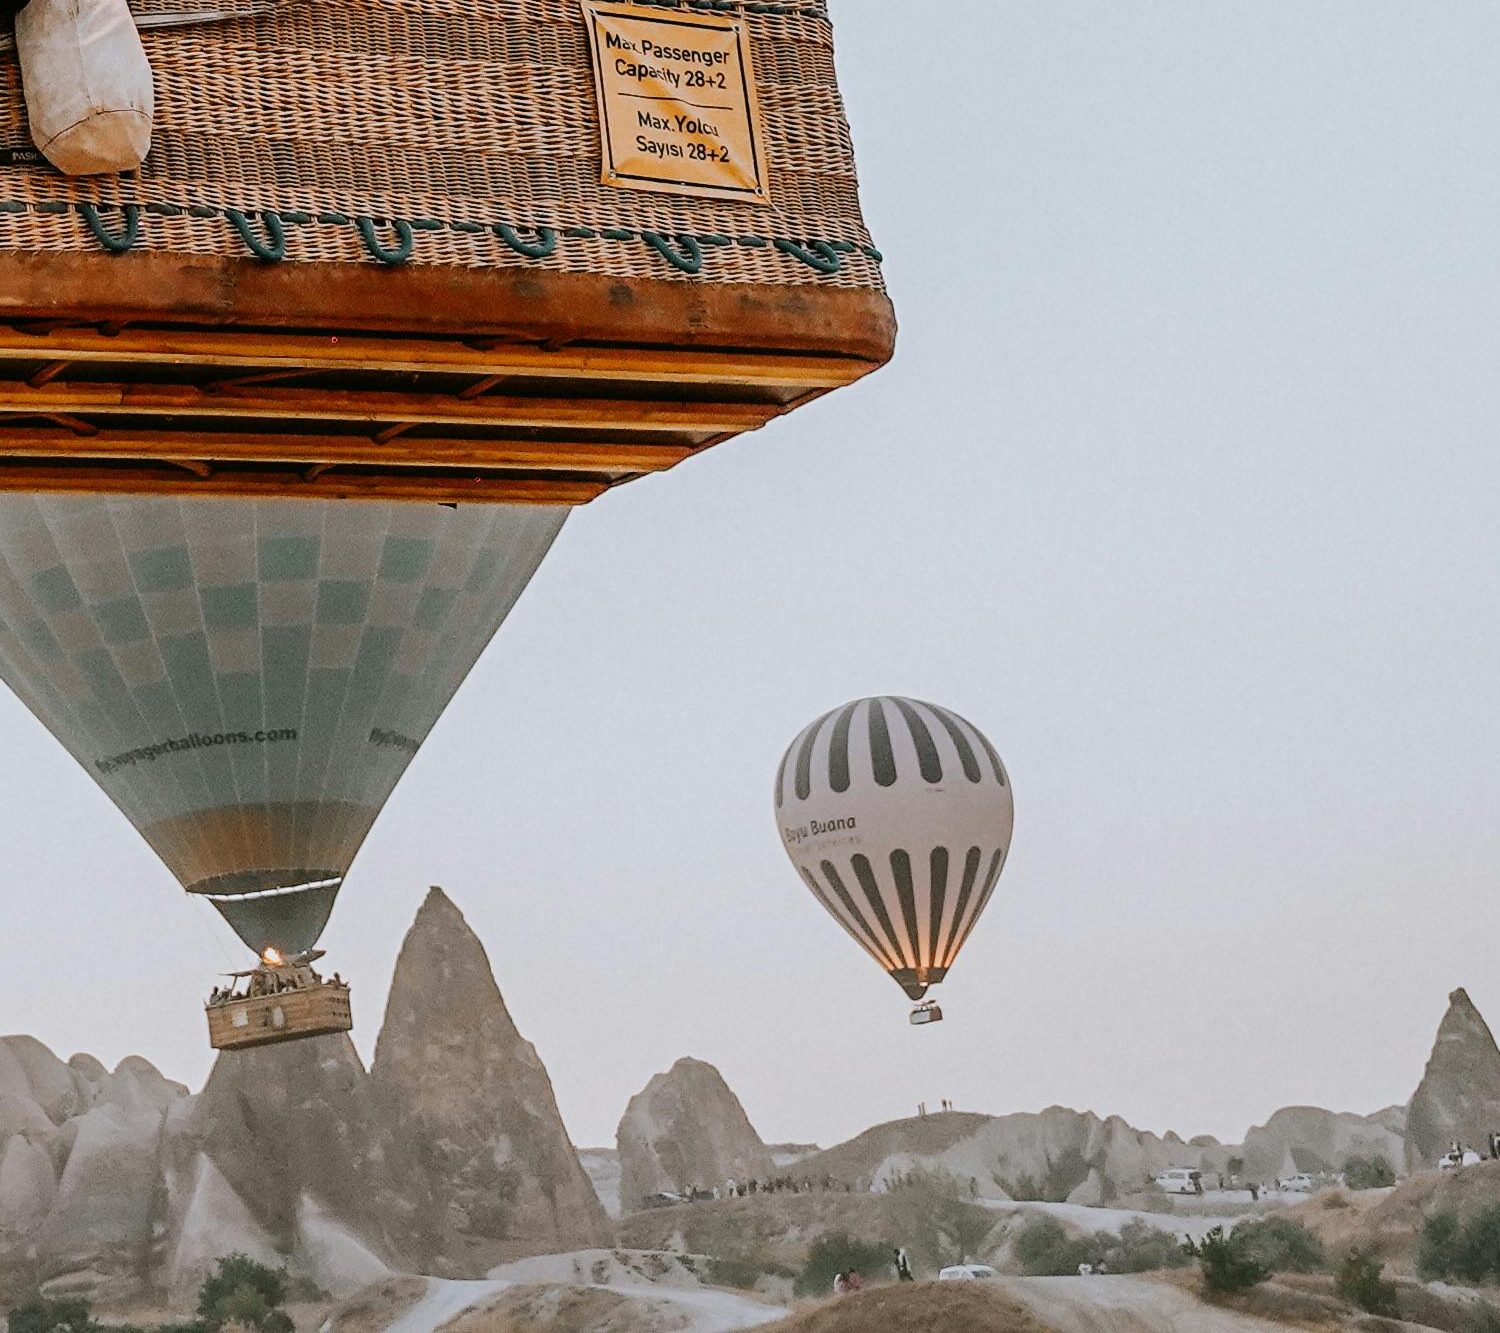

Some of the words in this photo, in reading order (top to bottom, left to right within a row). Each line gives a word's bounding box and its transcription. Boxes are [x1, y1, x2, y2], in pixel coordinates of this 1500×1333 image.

[615, 59, 680, 88] Capacity
[685, 71, 727, 90] 28+2
[687, 143, 730, 163] 28+2
[810, 817, 856, 836] Buana
